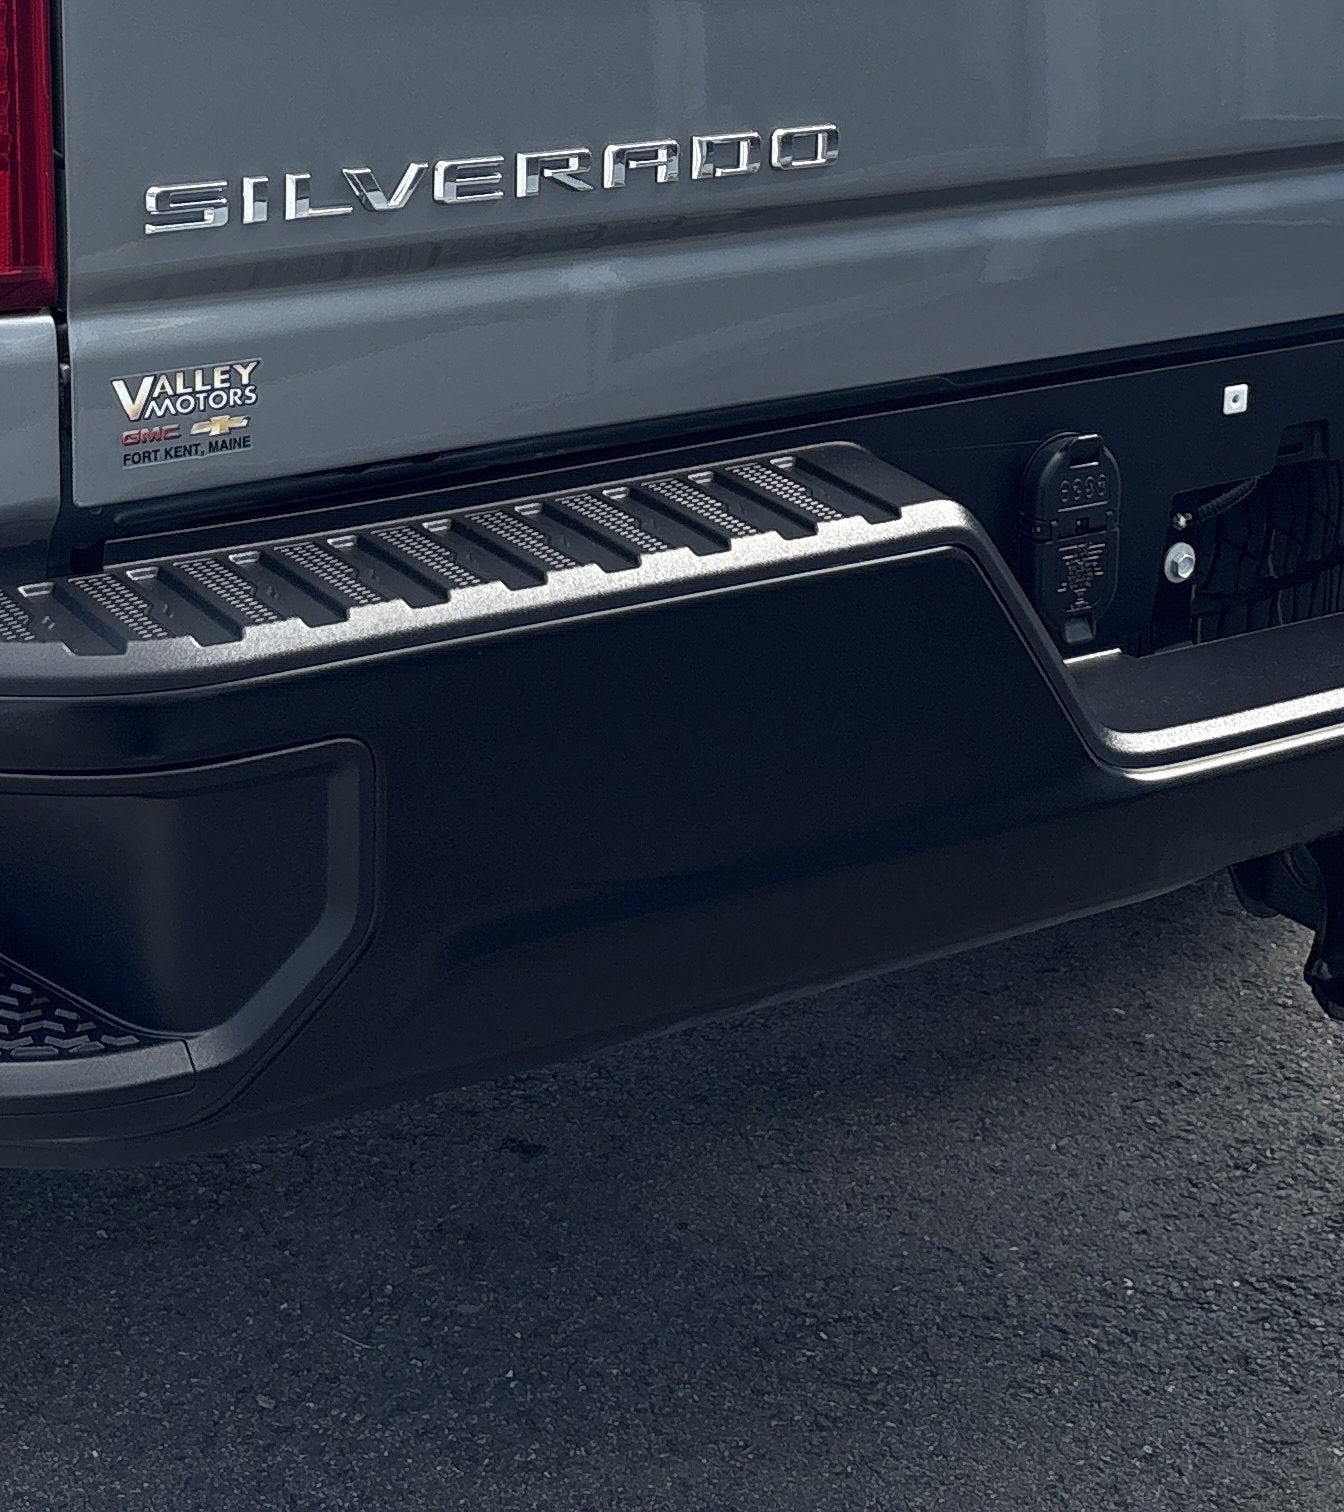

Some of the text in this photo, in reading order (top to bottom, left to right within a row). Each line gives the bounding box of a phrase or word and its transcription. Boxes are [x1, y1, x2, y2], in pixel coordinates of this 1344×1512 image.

[144, 123, 841, 235] SILVERADO
[110, 360, 260, 422] VALLEY
[142, 384, 258, 420] MOTORS
[121, 423, 182, 447] GMC
[122, 435, 252, 467] FORT KENT, MAINE
